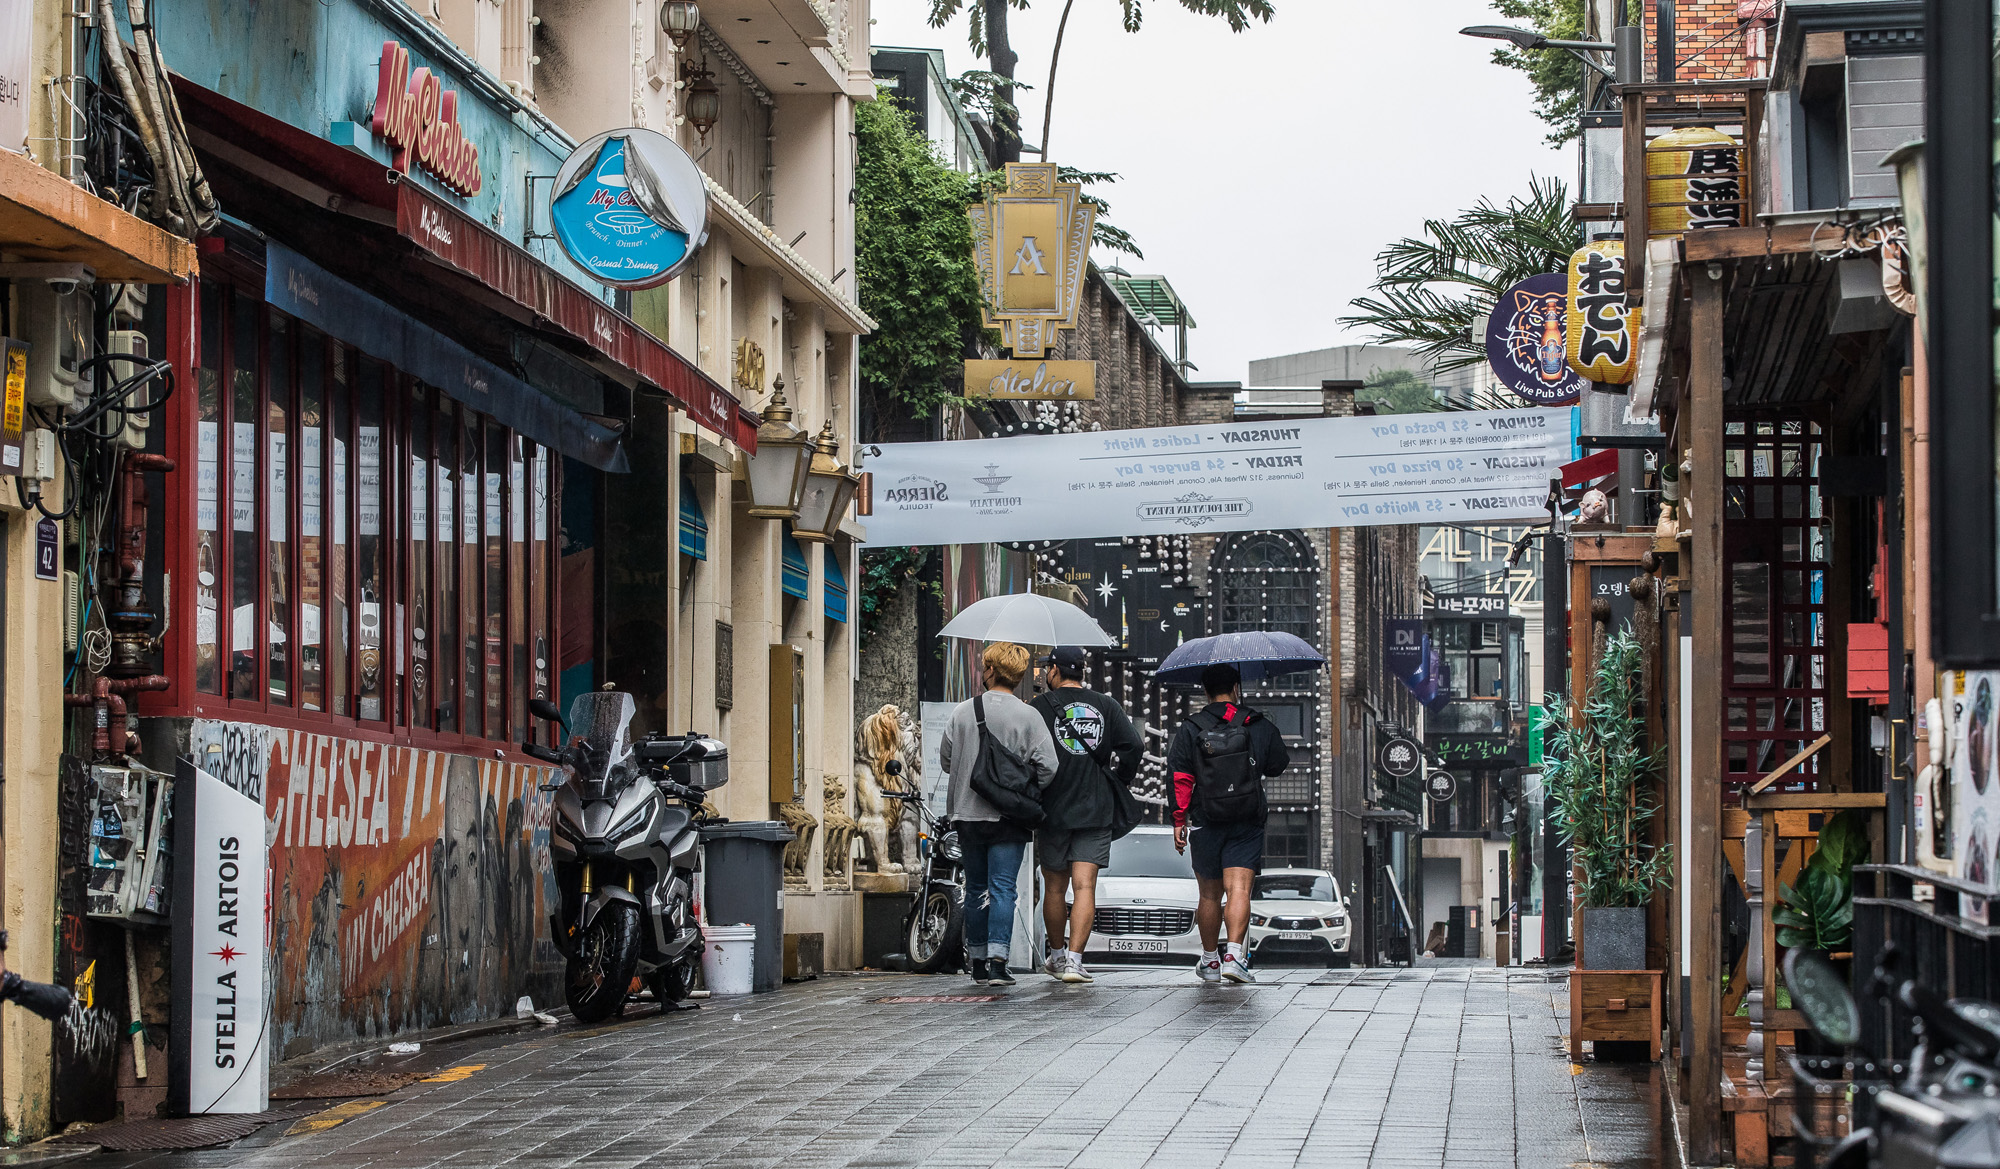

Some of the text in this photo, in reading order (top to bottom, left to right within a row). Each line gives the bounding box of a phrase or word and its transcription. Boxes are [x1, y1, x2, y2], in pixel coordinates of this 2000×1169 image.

[374, 41, 482, 198] My Chelsea
[586, 188, 615, 210] My
[1684, 145, 1741, 229] 居酒
[419, 203, 433, 243] My
[589, 256, 659, 273] Casual Dining
[1008, 236, 1048, 275] A
[1576, 251, 1631, 368] おでん
[989, 362, 1079, 397] Atelier
[1514, 377, 1588, 398] Live Pub & Club
[42, 546, 53, 570] 42
[1064, 566, 1091, 584] glam
[1438, 596, 1505, 615] 나는포차다
[1437, 740, 1508, 760] 부산갈비
[265, 729, 390, 849] CHELSEA
[343, 847, 429, 991] MY CHELSEA
[215, 836, 240, 1069] STELLA ARTOIS
[1138, 941, 1162, 952] 3750
